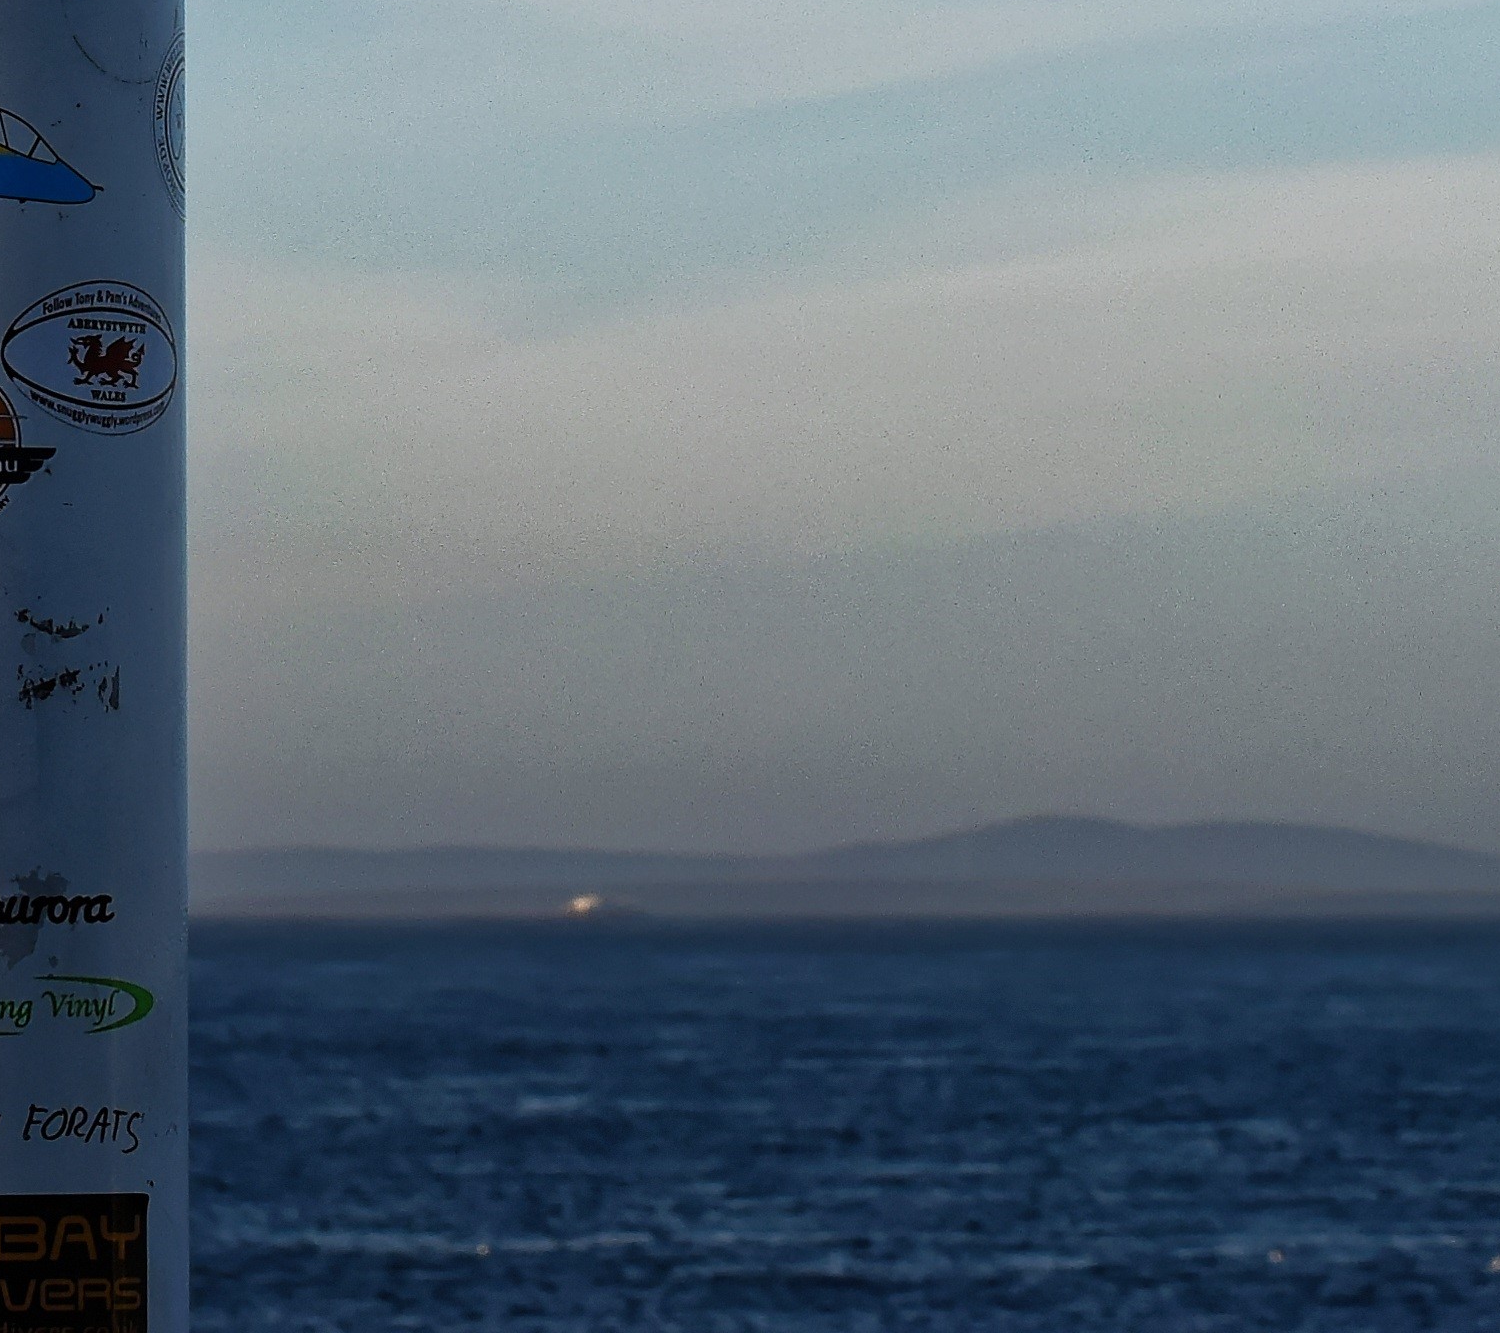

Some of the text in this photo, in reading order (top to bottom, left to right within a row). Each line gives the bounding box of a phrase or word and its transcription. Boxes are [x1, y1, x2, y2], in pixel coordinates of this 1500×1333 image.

[42, 297, 73, 315] Follow
[75, 292, 96, 305] Tony
[96, 290, 104, 303] &
[105, 290, 127, 304] Pam's
[67, 318, 147, 335] ABERYSTWYTH
[90, 389, 126, 402] WALES
[41, 989, 121, 1026] Vinyl
[22, 1103, 142, 1154] FORATS
